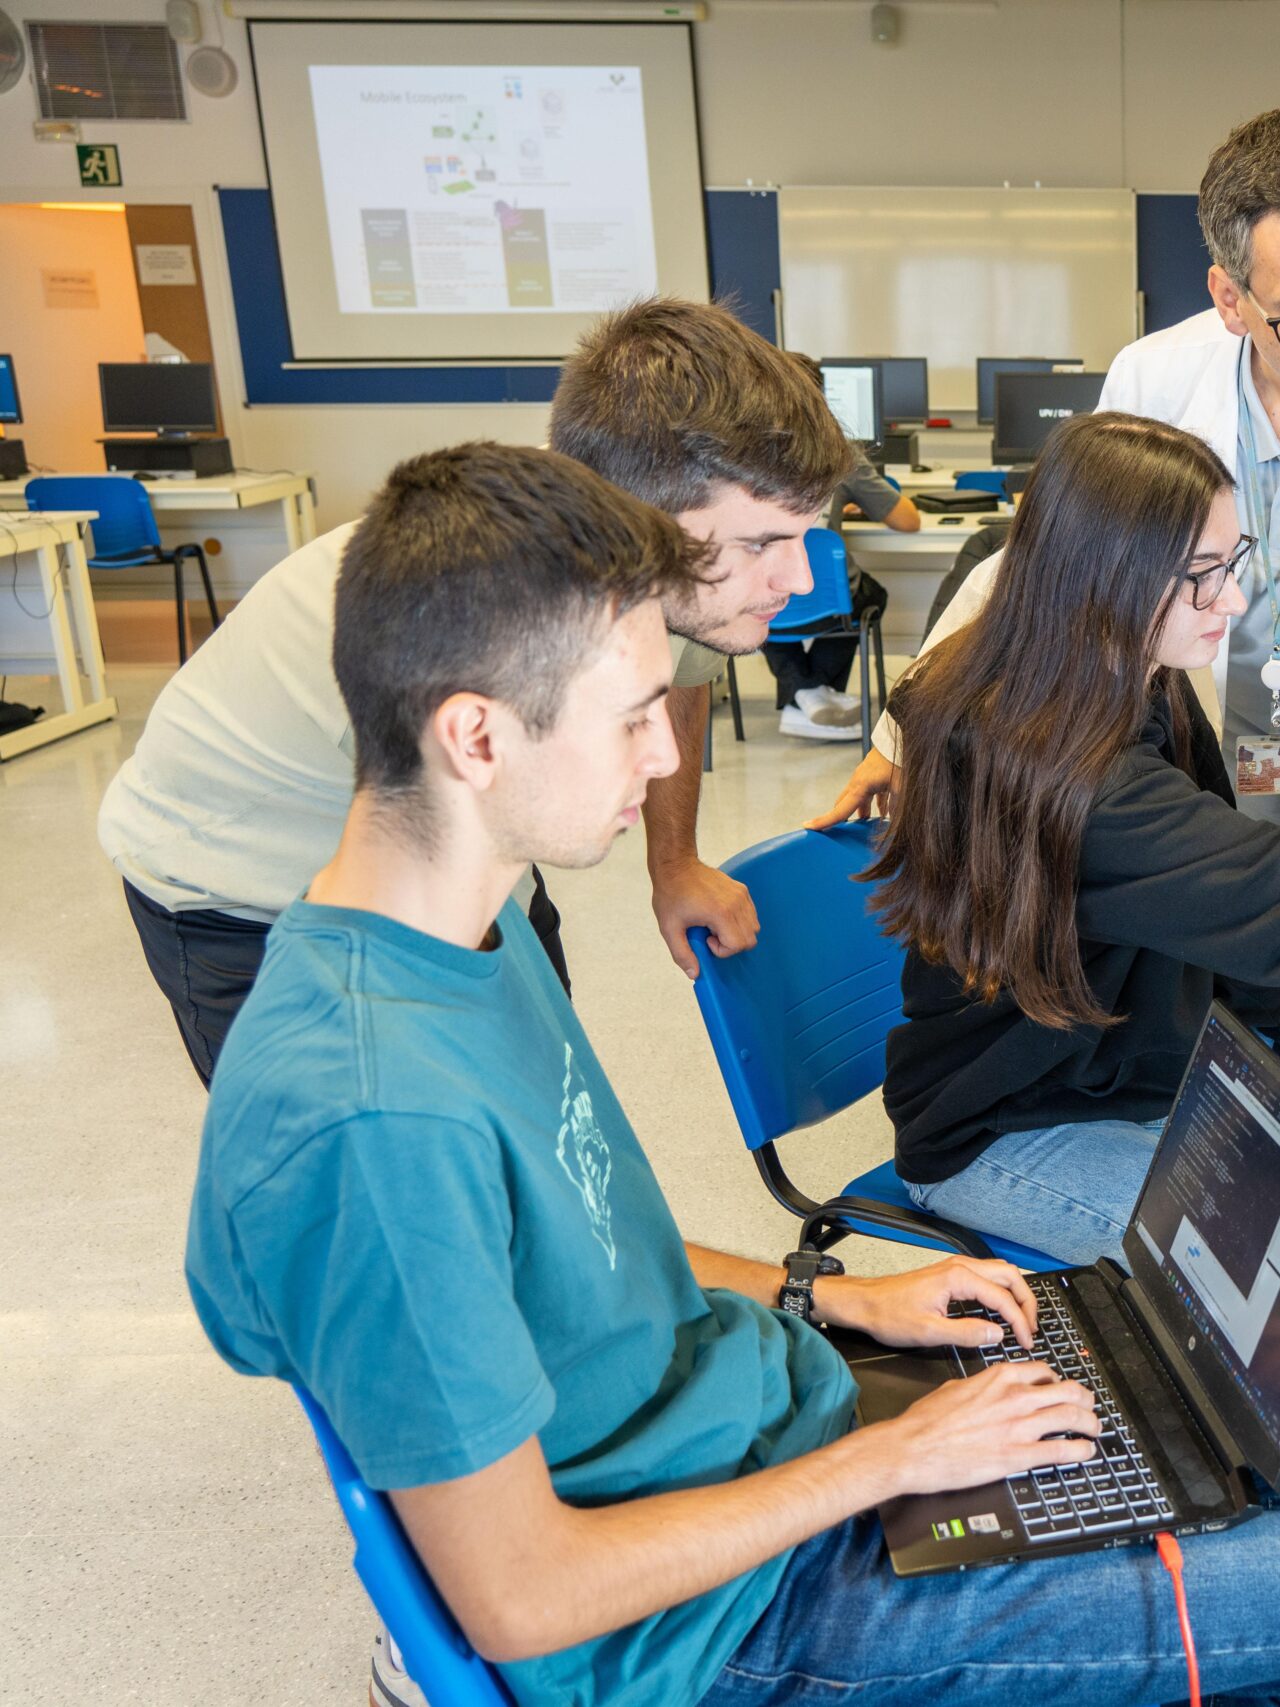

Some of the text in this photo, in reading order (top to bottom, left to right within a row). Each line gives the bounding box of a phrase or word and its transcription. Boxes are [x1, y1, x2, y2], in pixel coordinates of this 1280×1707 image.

[360, 90, 468, 106] Mobile Ecosystem
[1039, 408, 1054, 418] UPV
